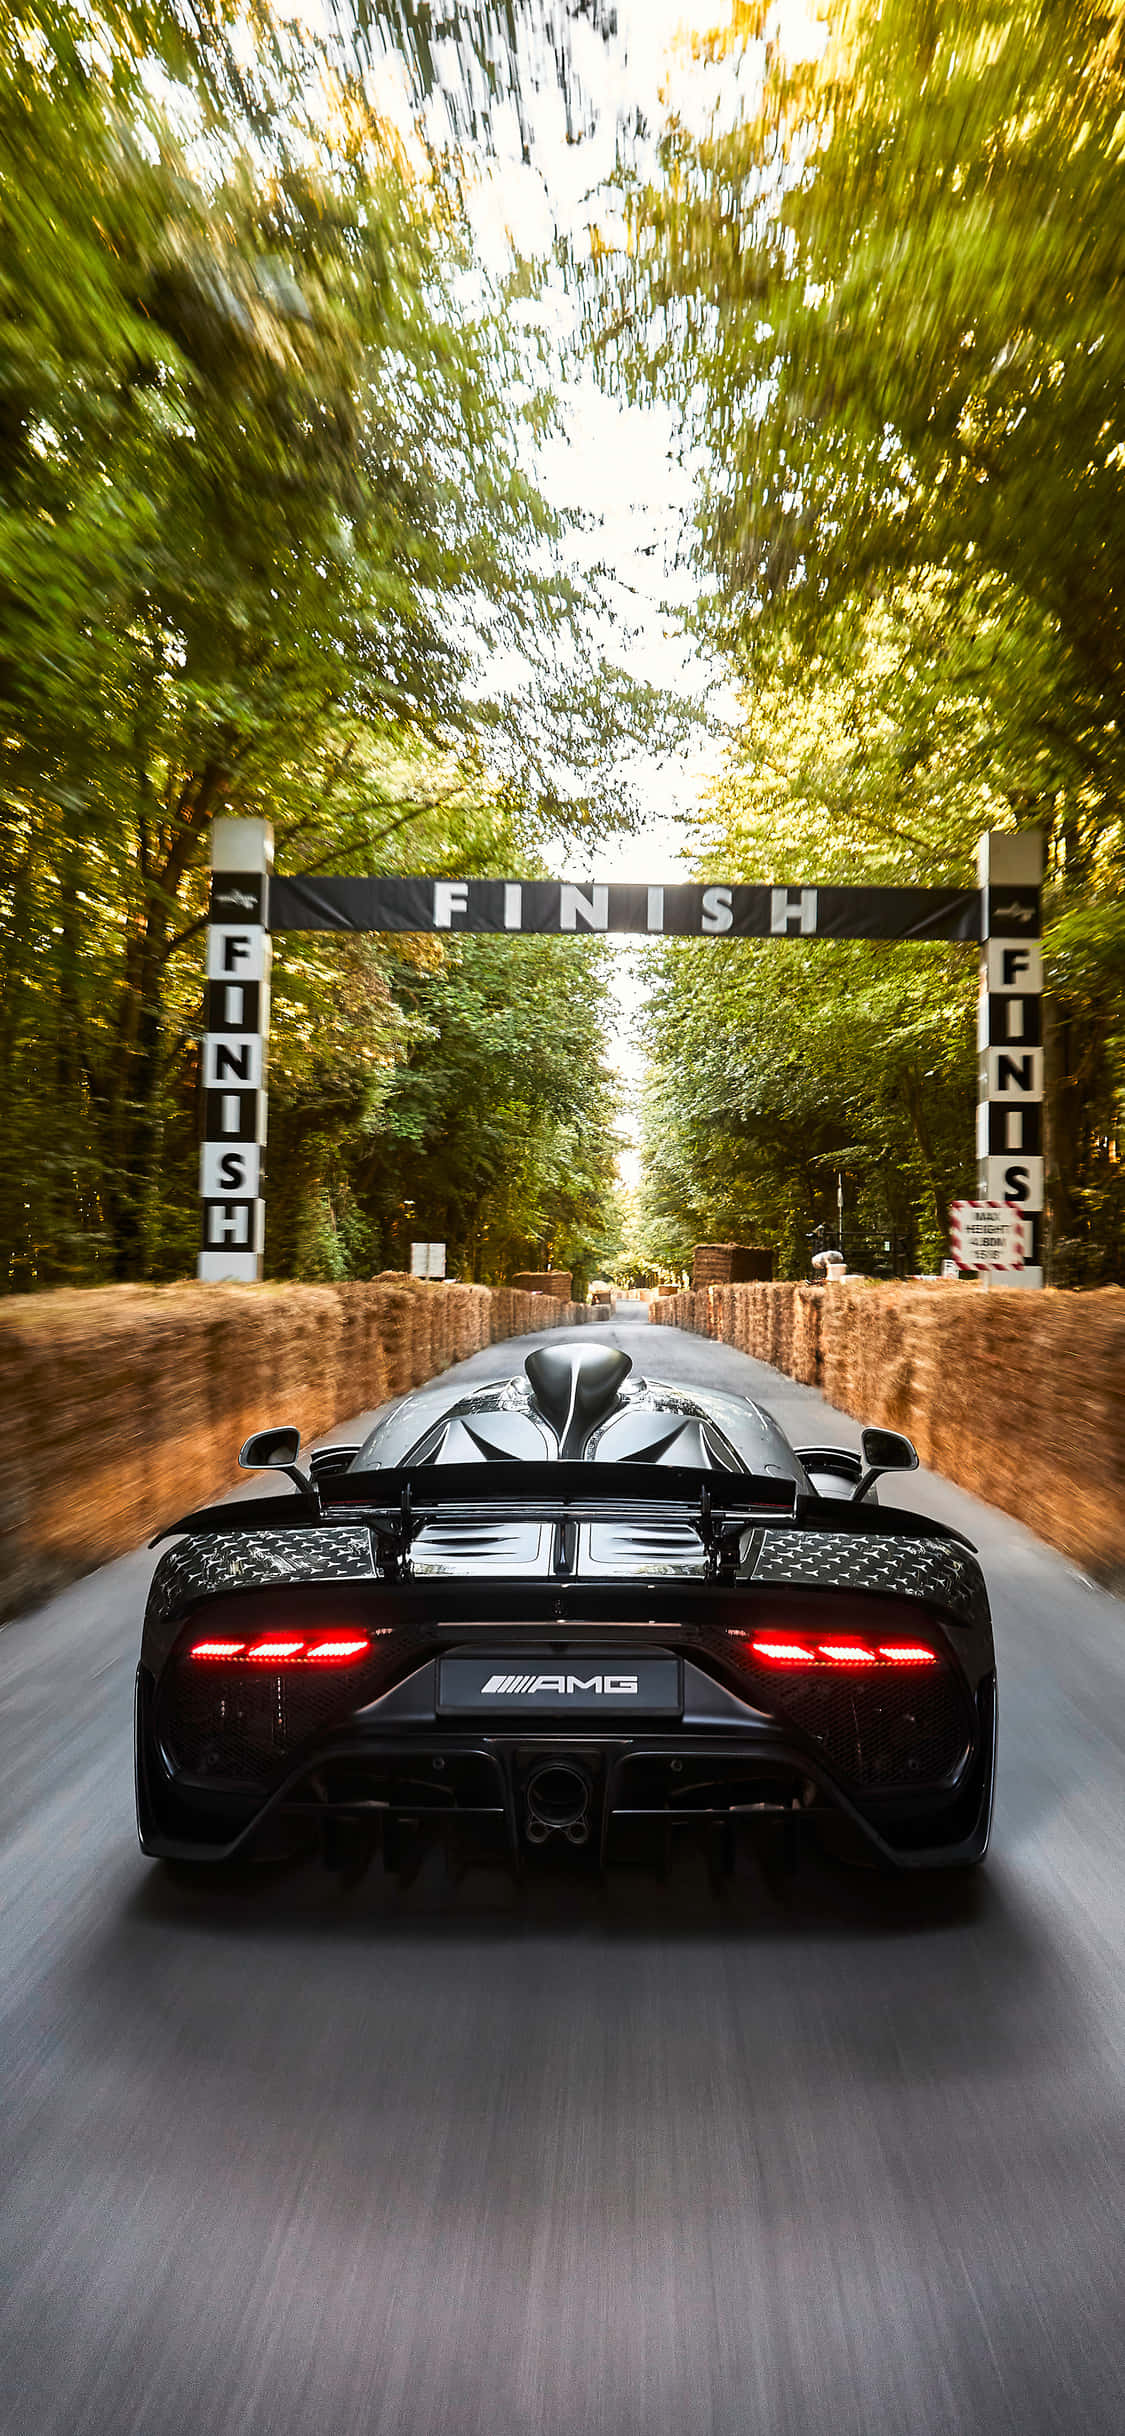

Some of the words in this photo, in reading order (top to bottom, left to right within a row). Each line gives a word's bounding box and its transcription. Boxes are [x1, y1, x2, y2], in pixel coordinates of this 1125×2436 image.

[433, 881, 818, 934] FINISH
[208, 935, 250, 1244] FINISH
[965, 1224, 1012, 1234] HEIGHT
[528, 1675, 638, 1694] AMG
